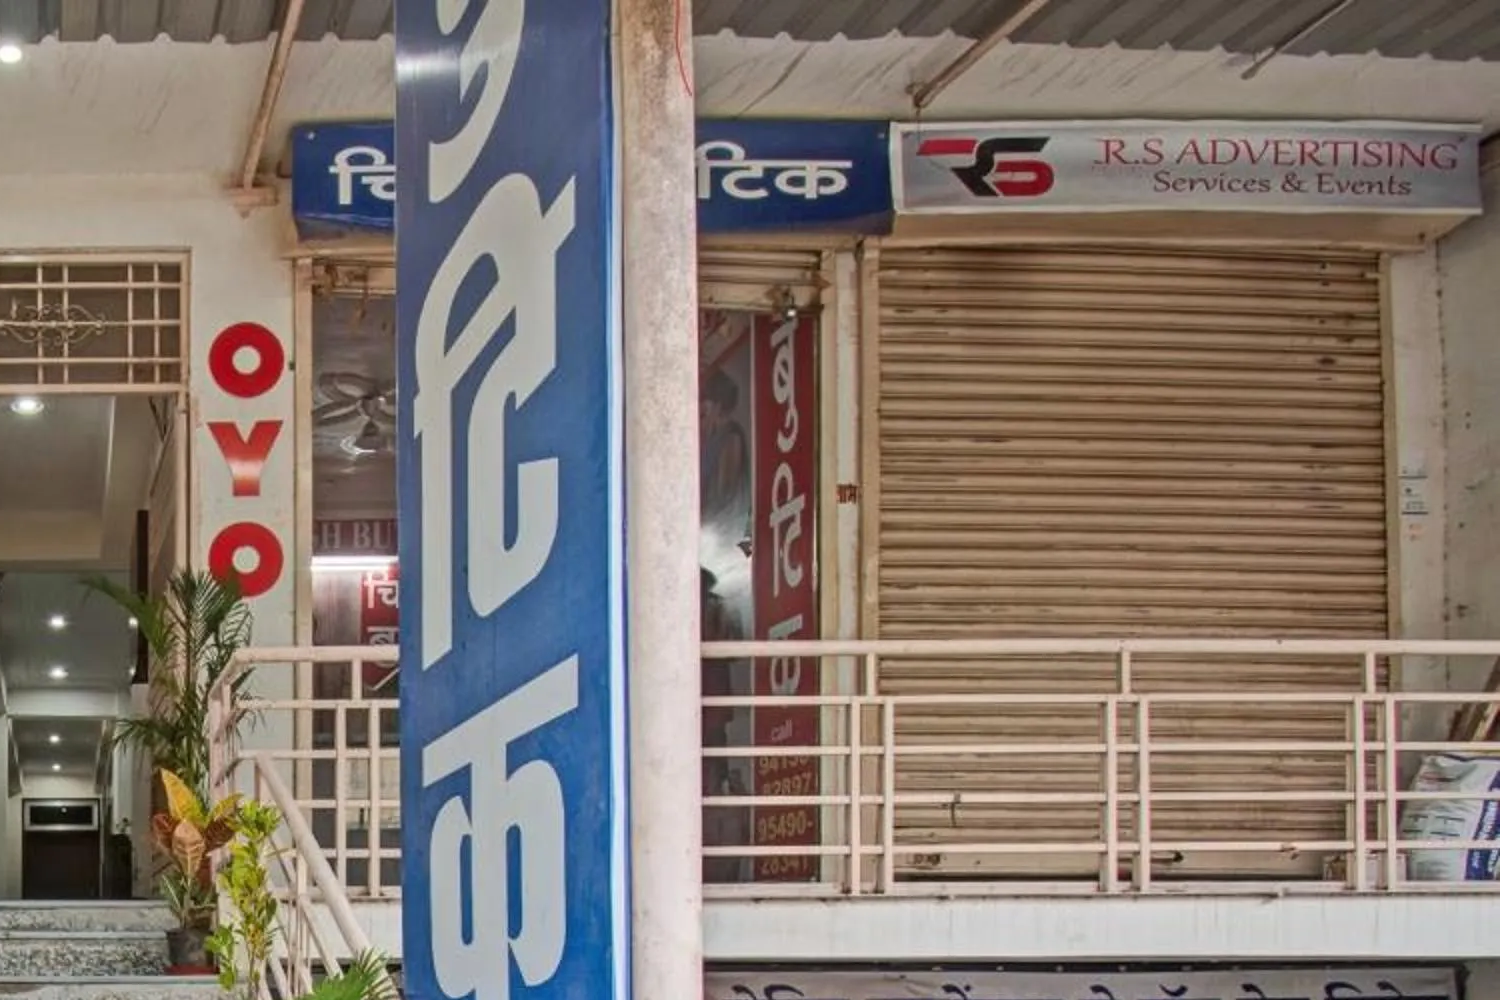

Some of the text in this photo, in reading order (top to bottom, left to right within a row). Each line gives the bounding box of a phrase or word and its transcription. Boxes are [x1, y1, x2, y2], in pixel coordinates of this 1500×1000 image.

[1176, 138, 1461, 170] ADVERTISING
[1153, 170, 1413, 195] Services & Events
[208, 321, 285, 598] OYO
